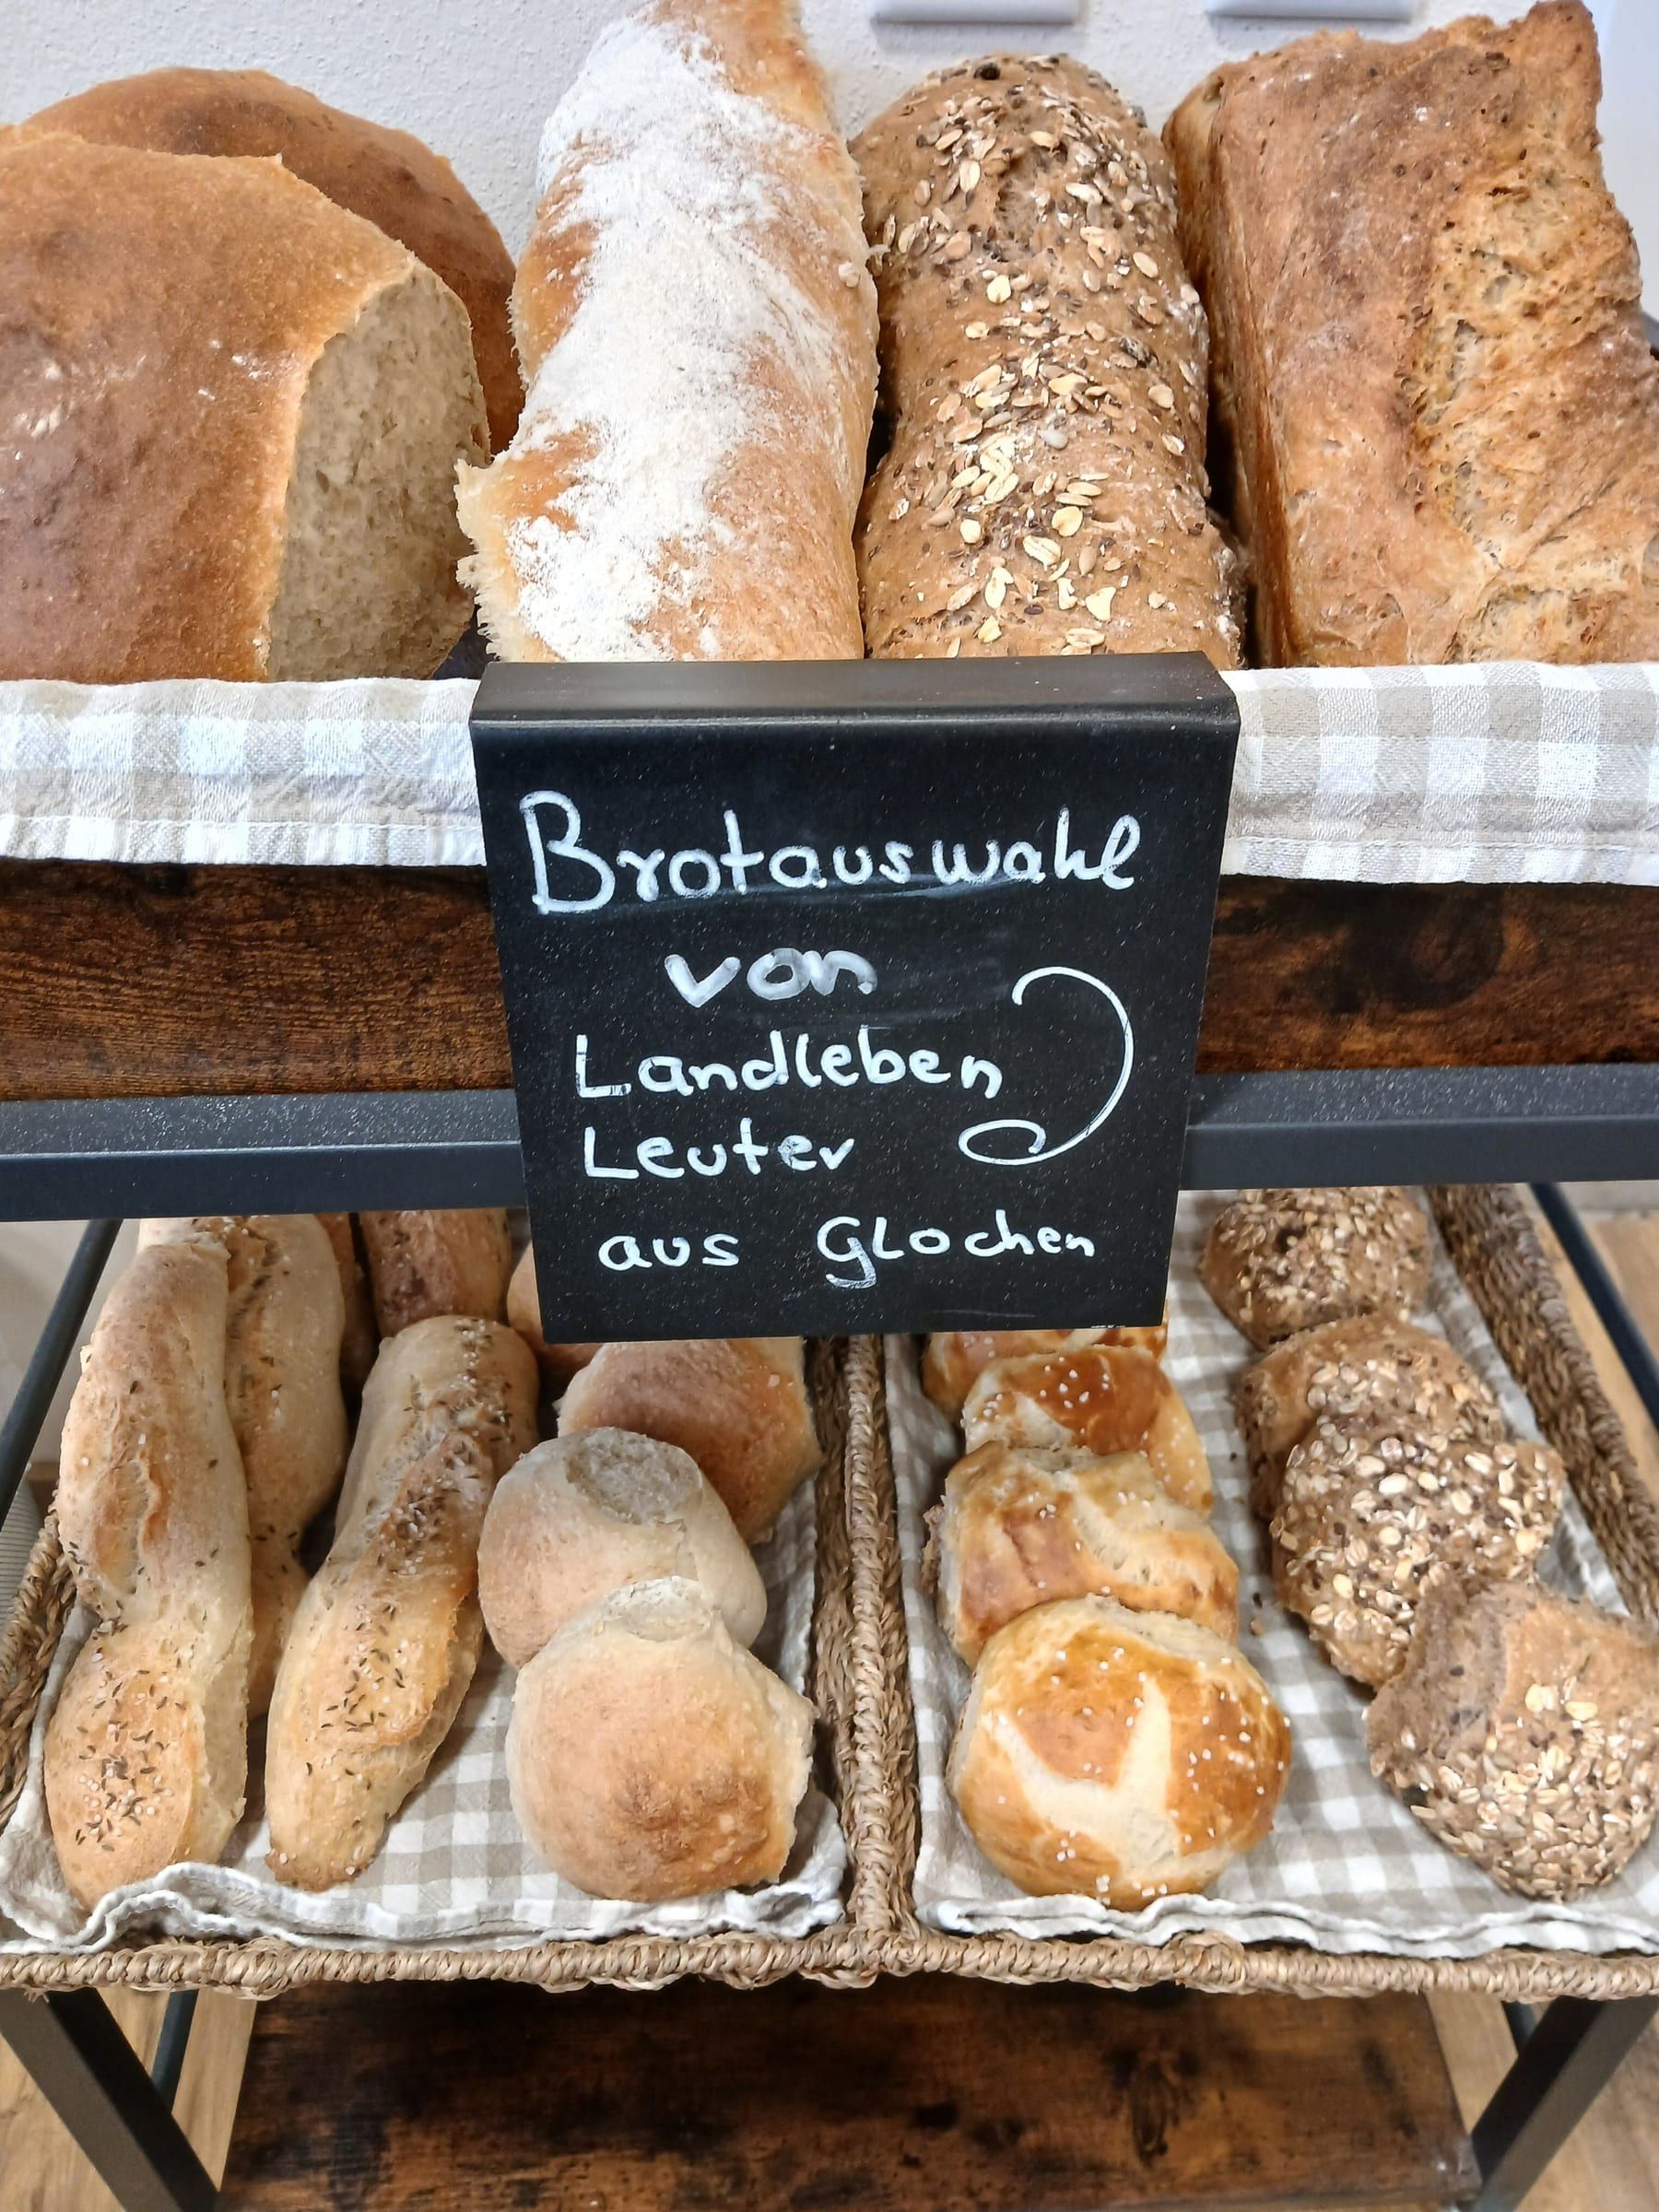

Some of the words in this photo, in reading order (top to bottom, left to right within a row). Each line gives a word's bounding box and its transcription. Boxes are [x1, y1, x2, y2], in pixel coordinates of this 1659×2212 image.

[519, 790, 1141, 915] Brotauswahl
[664, 947, 876, 1008] von
[575, 1024, 1003, 1100] Landleben
[583, 1117, 855, 1180] Leuter
[598, 1233, 739, 1271] aus
